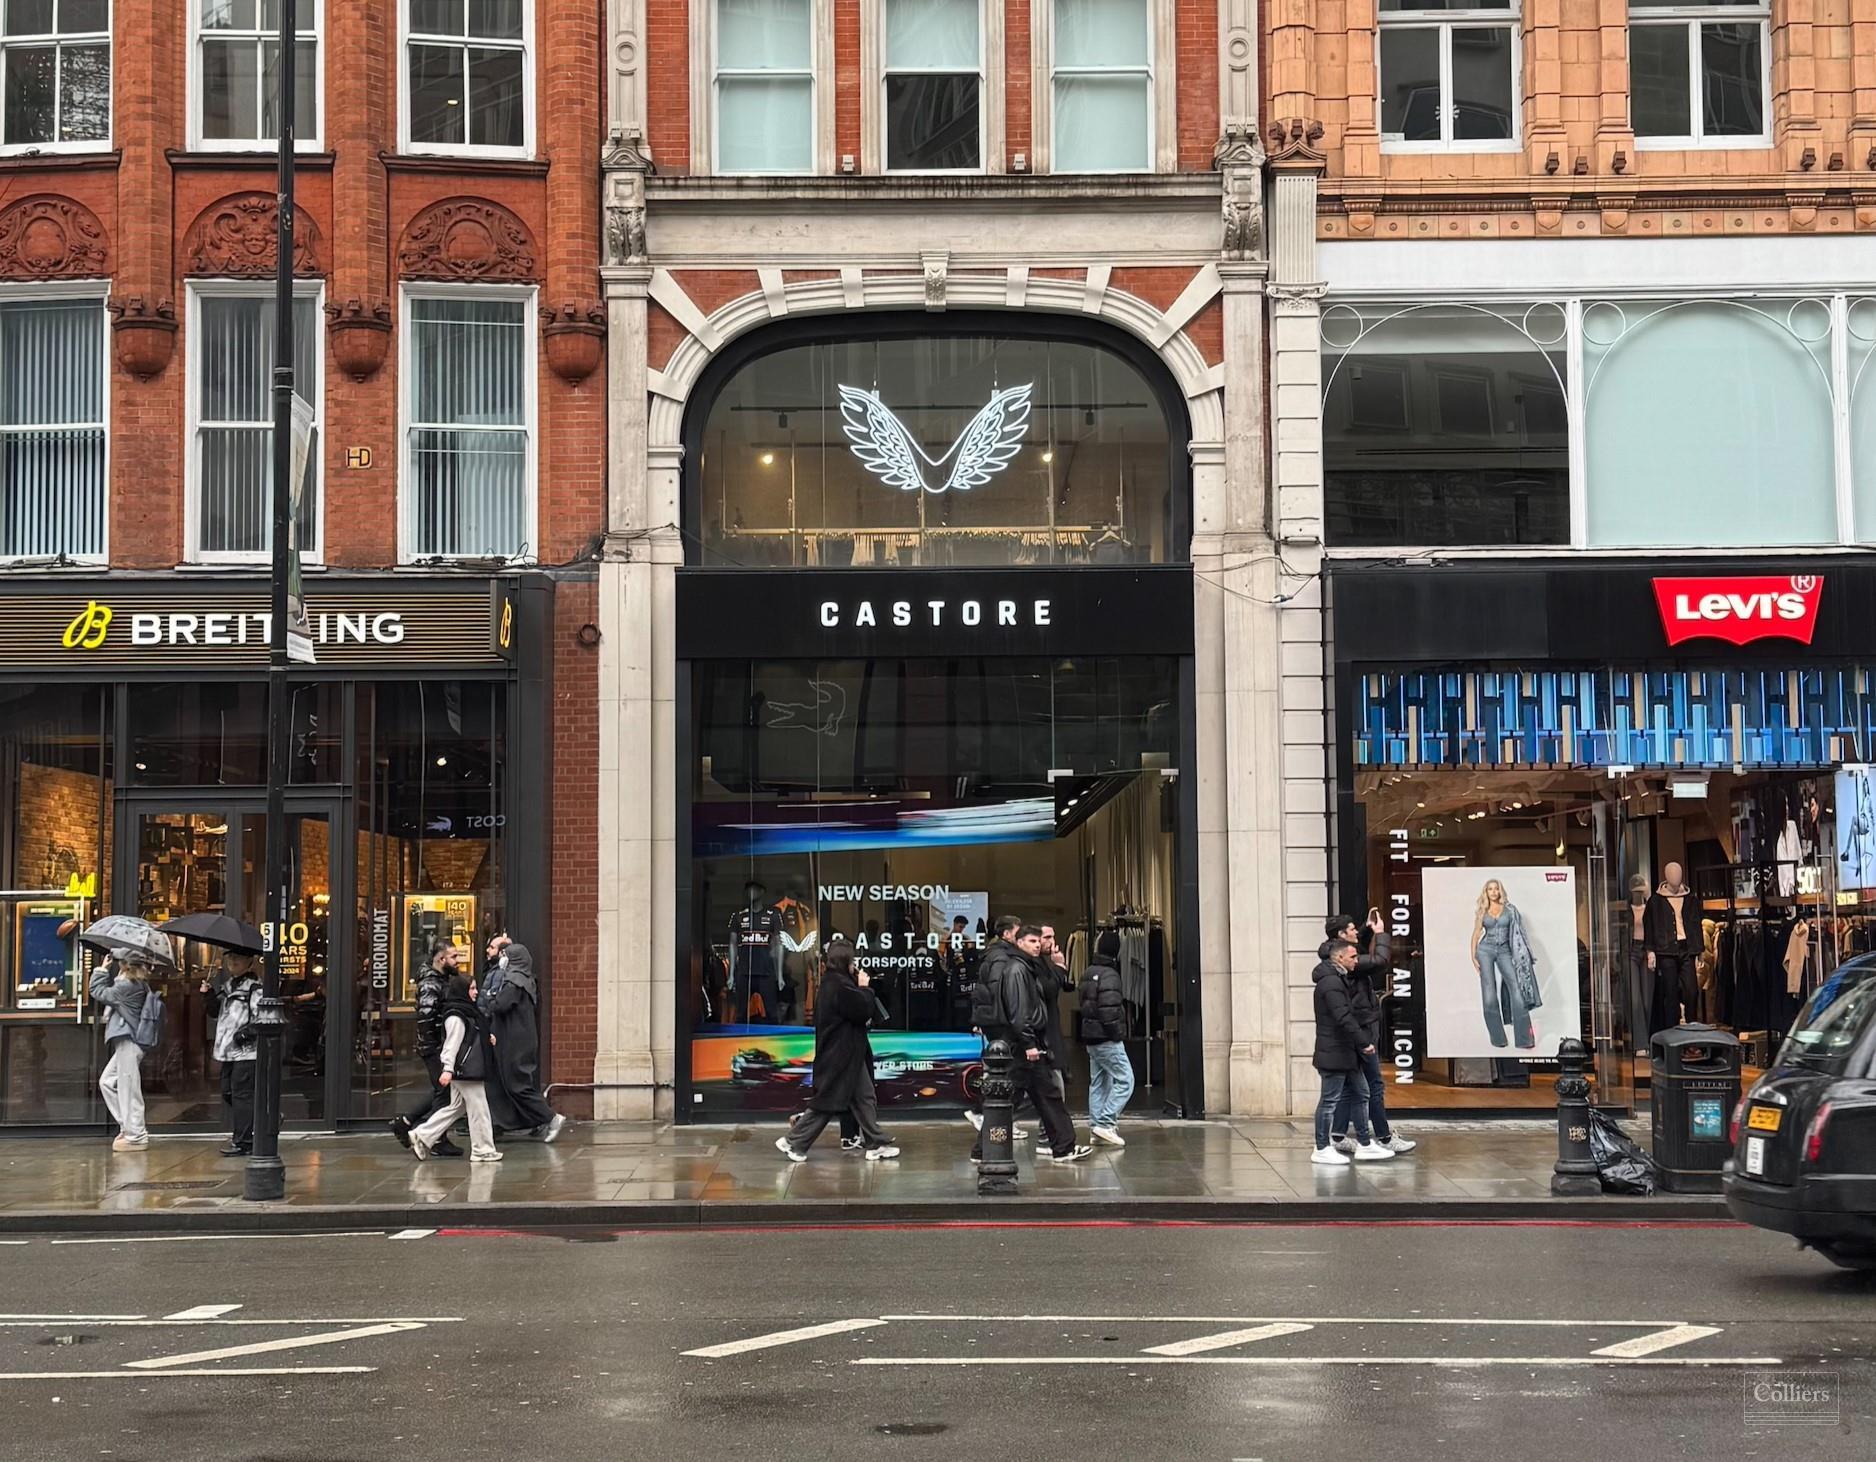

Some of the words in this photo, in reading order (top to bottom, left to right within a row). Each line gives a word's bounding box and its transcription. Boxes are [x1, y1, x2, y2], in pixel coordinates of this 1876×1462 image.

[131, 612, 404, 645] BREITING
[820, 600, 1051, 627] CASTORE
[1389, 829, 1408, 863] FIT
[819, 885, 864, 901] NEW
[869, 885, 949, 900] SEASON
[1391, 894, 1410, 937] FOR
[279, 945, 307, 955] ARS
[372, 908, 388, 989] CHRONOMAT
[854, 957, 933, 968] TORSPORTS
[1393, 967, 1411, 997] AN
[1394, 1030, 1414, 1084] ICON
